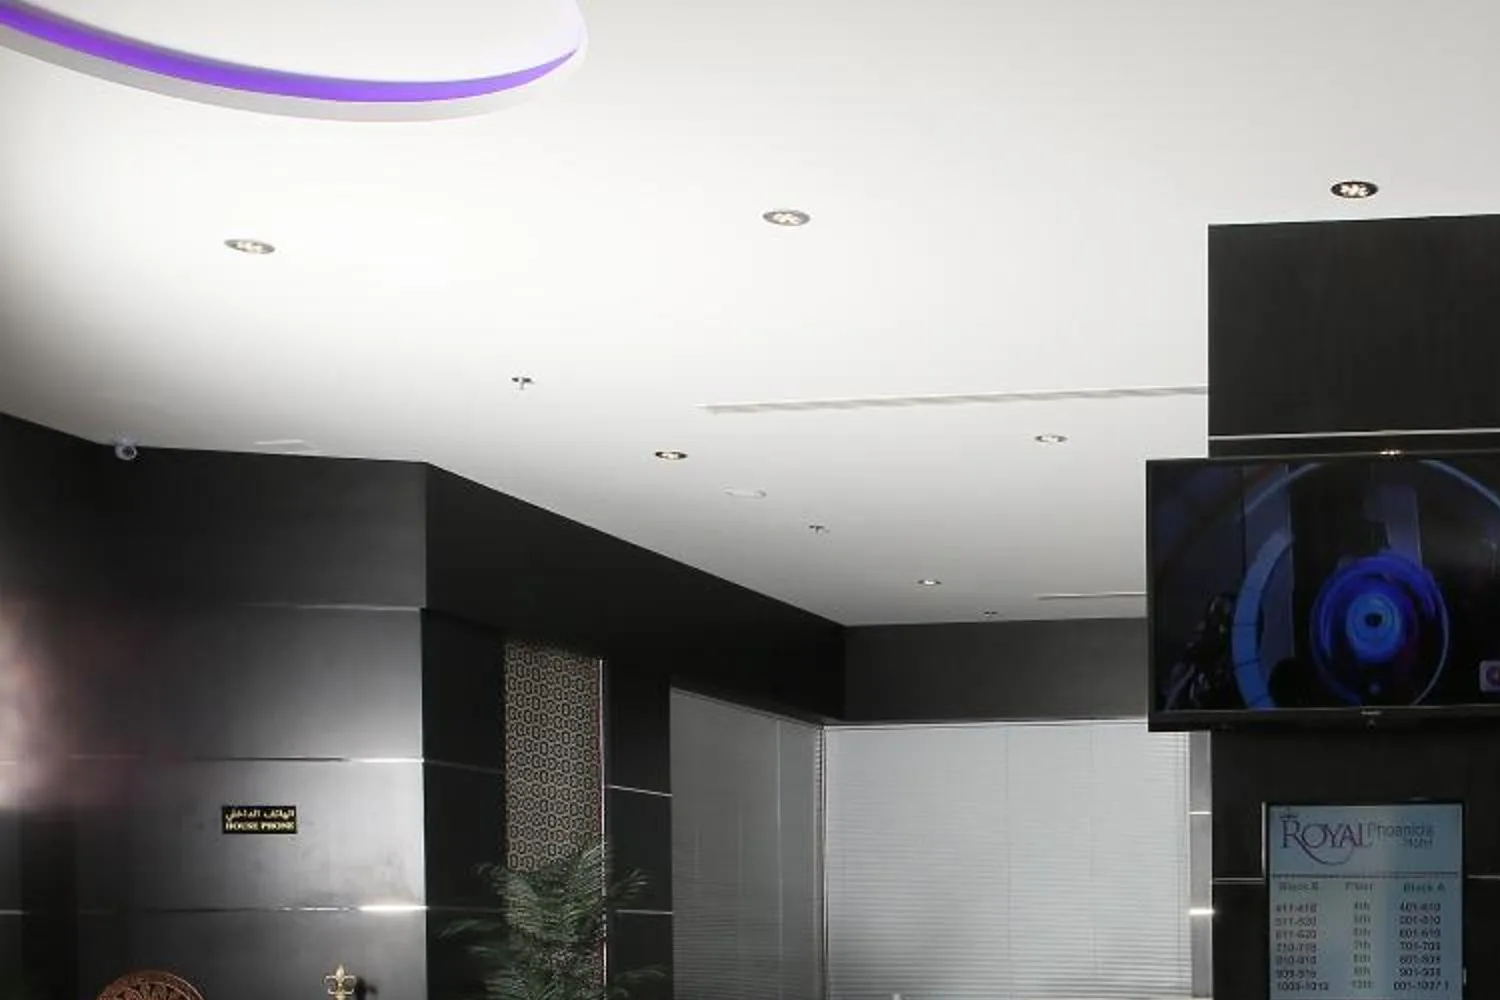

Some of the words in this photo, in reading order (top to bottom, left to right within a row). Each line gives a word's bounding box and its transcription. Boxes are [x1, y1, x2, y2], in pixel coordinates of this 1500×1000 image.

[225, 821, 259, 831] HOUSE
[261, 820, 295, 831] PHONE
[1281, 818, 1372, 851] ROYAL
